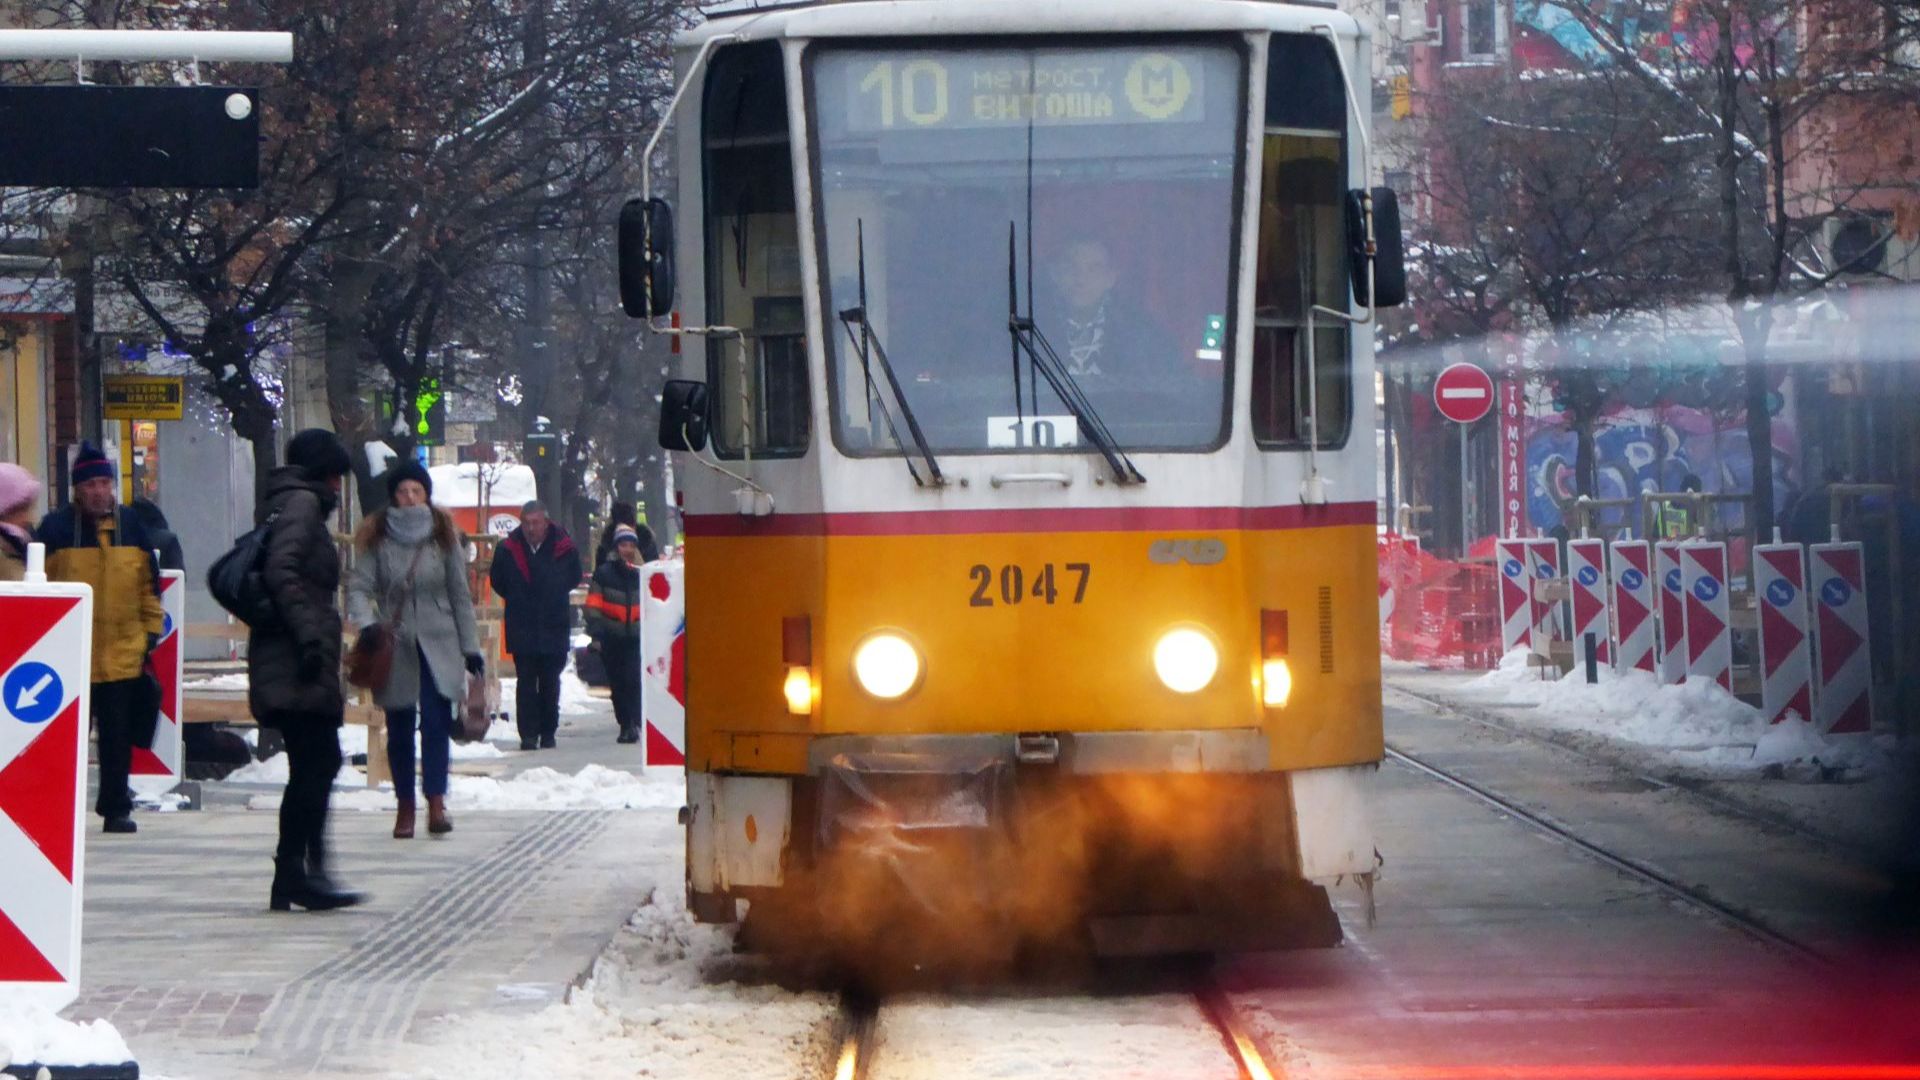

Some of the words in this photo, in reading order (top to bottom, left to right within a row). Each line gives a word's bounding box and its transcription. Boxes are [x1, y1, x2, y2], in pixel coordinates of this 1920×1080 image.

[859, 59, 949, 128] 10
[973, 92, 1113, 121] ВИТОША
[1008, 420, 1056, 447] 10
[1507, 425, 1519, 492] МОЛЯ
[494, 519, 512, 530] WC
[969, 562, 1091, 608] 2047
